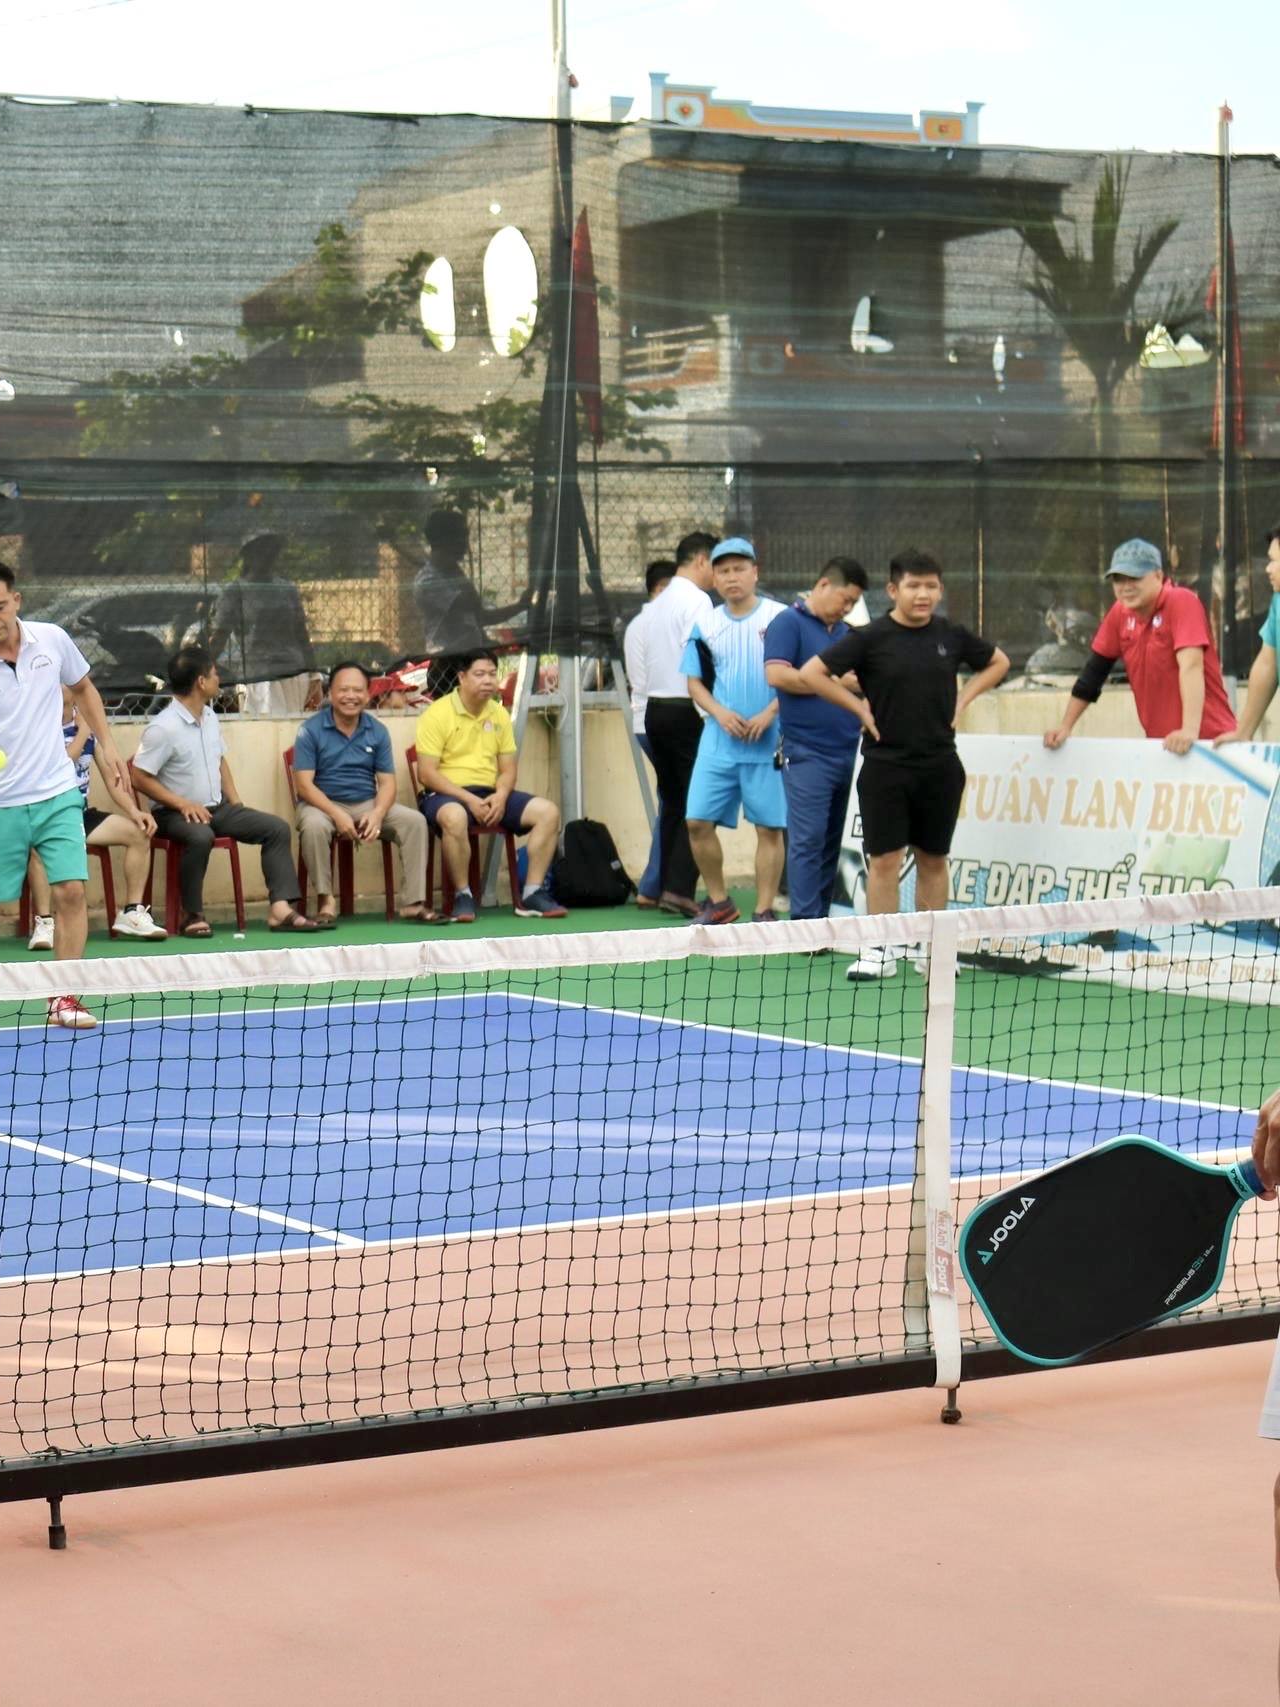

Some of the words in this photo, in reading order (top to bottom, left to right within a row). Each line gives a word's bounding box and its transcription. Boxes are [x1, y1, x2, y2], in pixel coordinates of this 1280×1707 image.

[958, 754, 1055, 825] TUẤN
[1060, 777, 1141, 831] LAN
[1147, 782, 1246, 837] BIKE
[989, 1197, 1036, 1252] JOOLA
[935, 1255, 950, 1293] Sport
